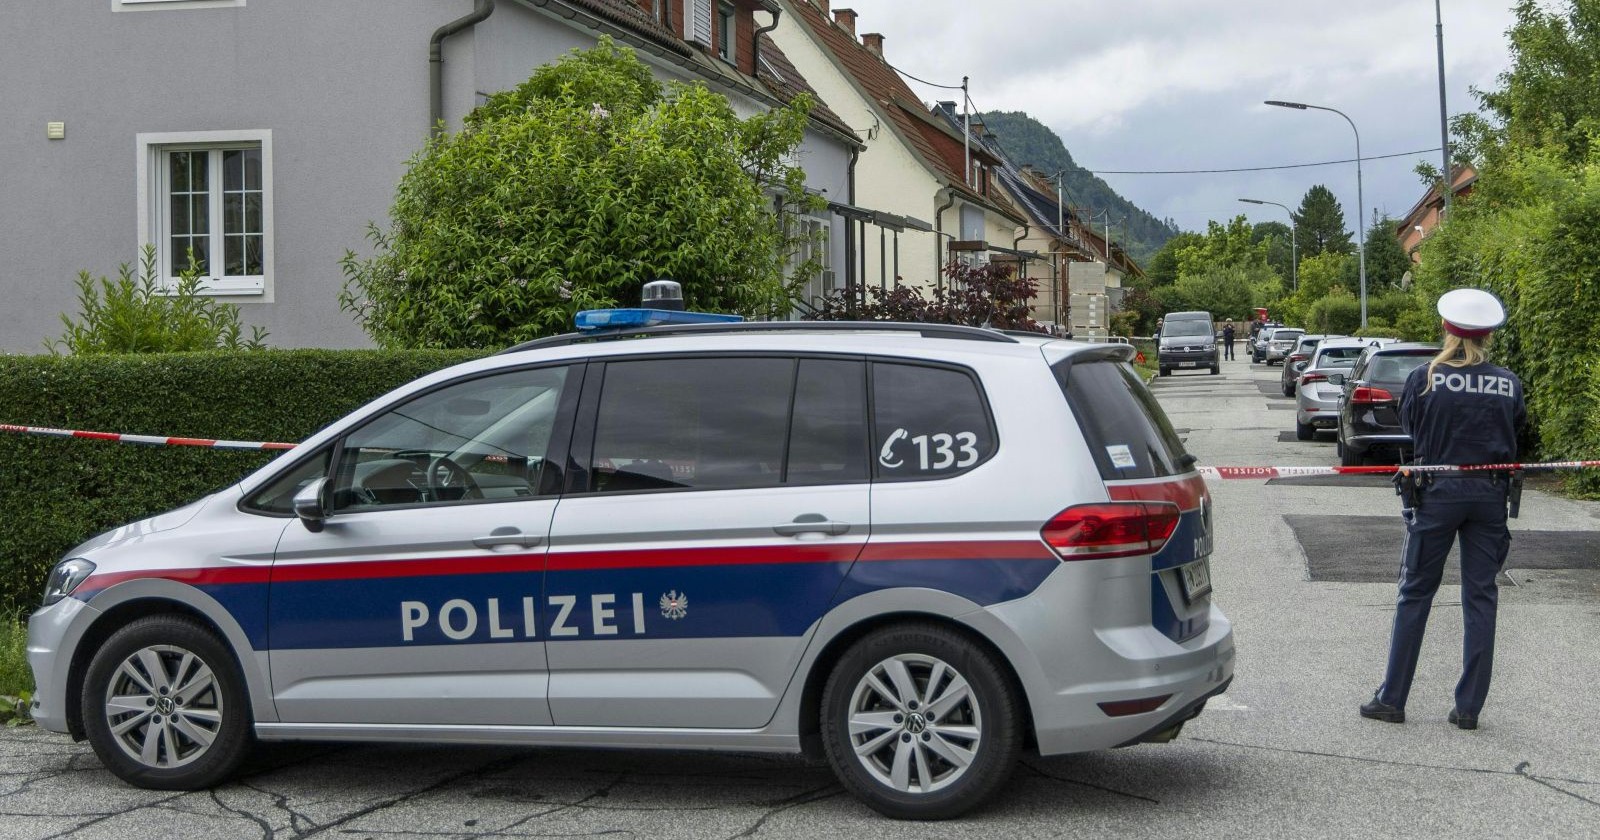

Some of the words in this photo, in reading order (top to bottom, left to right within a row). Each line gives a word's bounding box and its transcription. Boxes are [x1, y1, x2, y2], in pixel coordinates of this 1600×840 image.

[1431, 373, 1514, 397] POLIZEI
[911, 431, 979, 470] 133
[401, 592, 646, 641] POLIZEI
